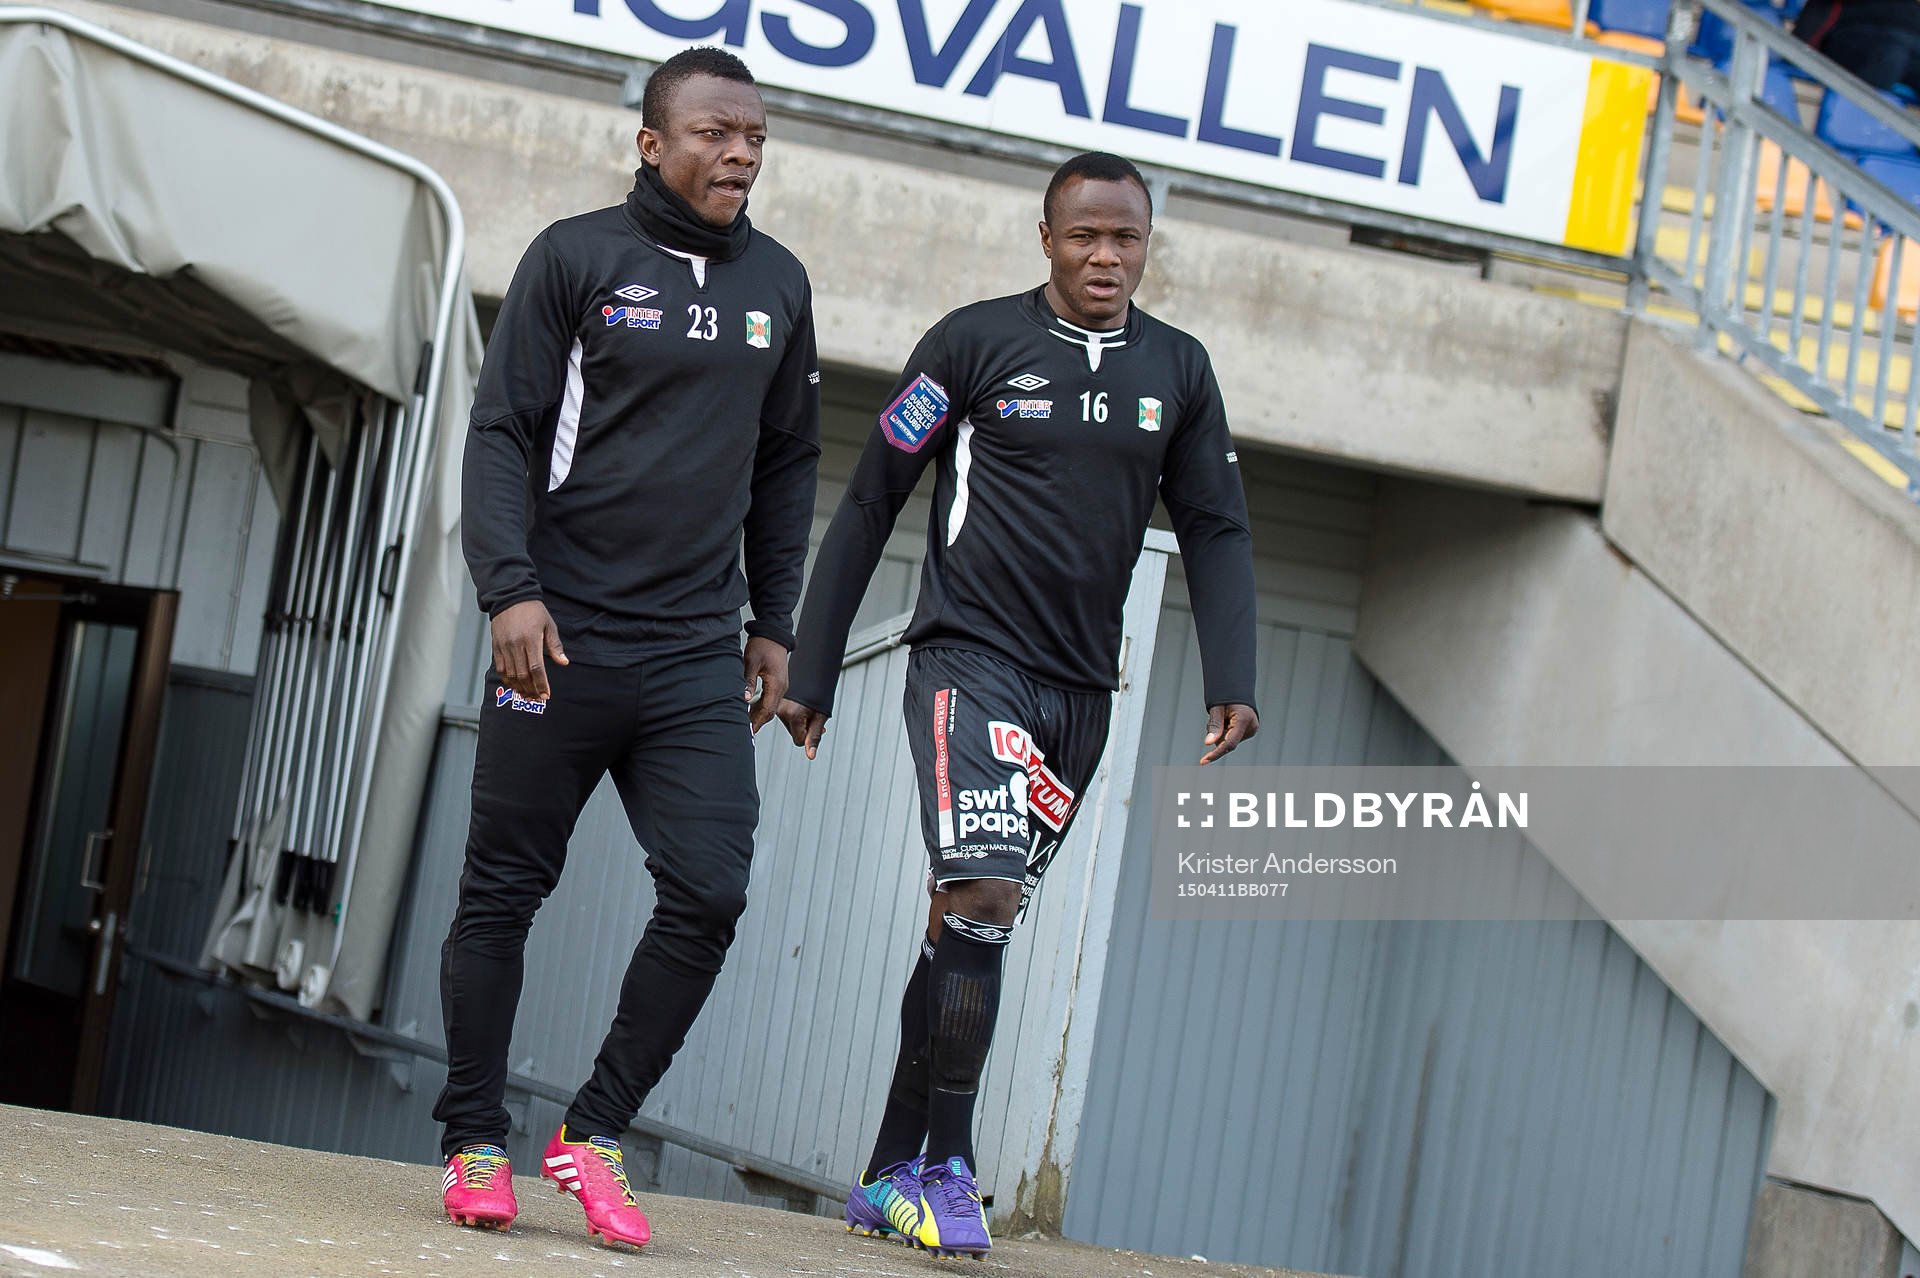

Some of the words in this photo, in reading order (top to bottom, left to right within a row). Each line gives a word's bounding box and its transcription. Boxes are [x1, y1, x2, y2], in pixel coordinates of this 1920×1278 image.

[626, 306, 660, 319] INTER
[627, 317, 660, 329] SPORT
[686, 303, 718, 341] 23
[902, 398, 932, 430] FOTBOLLS
[909, 393, 937, 424] SVERIGES
[919, 393, 937, 412] HELA
[1019, 400, 1051, 410] INTER
[1020, 409, 1051, 418] SPORT
[1079, 390, 1109, 423] 16
[901, 408, 922, 432] KLUBB
[512, 700, 546, 713] SPORT
[938, 738, 949, 798] anderssons
[958, 784, 1009, 811] swt
[959, 811, 1030, 841] pape
[960, 844, 989, 852] CUSTOM
[989, 843, 1009, 852] MADE
